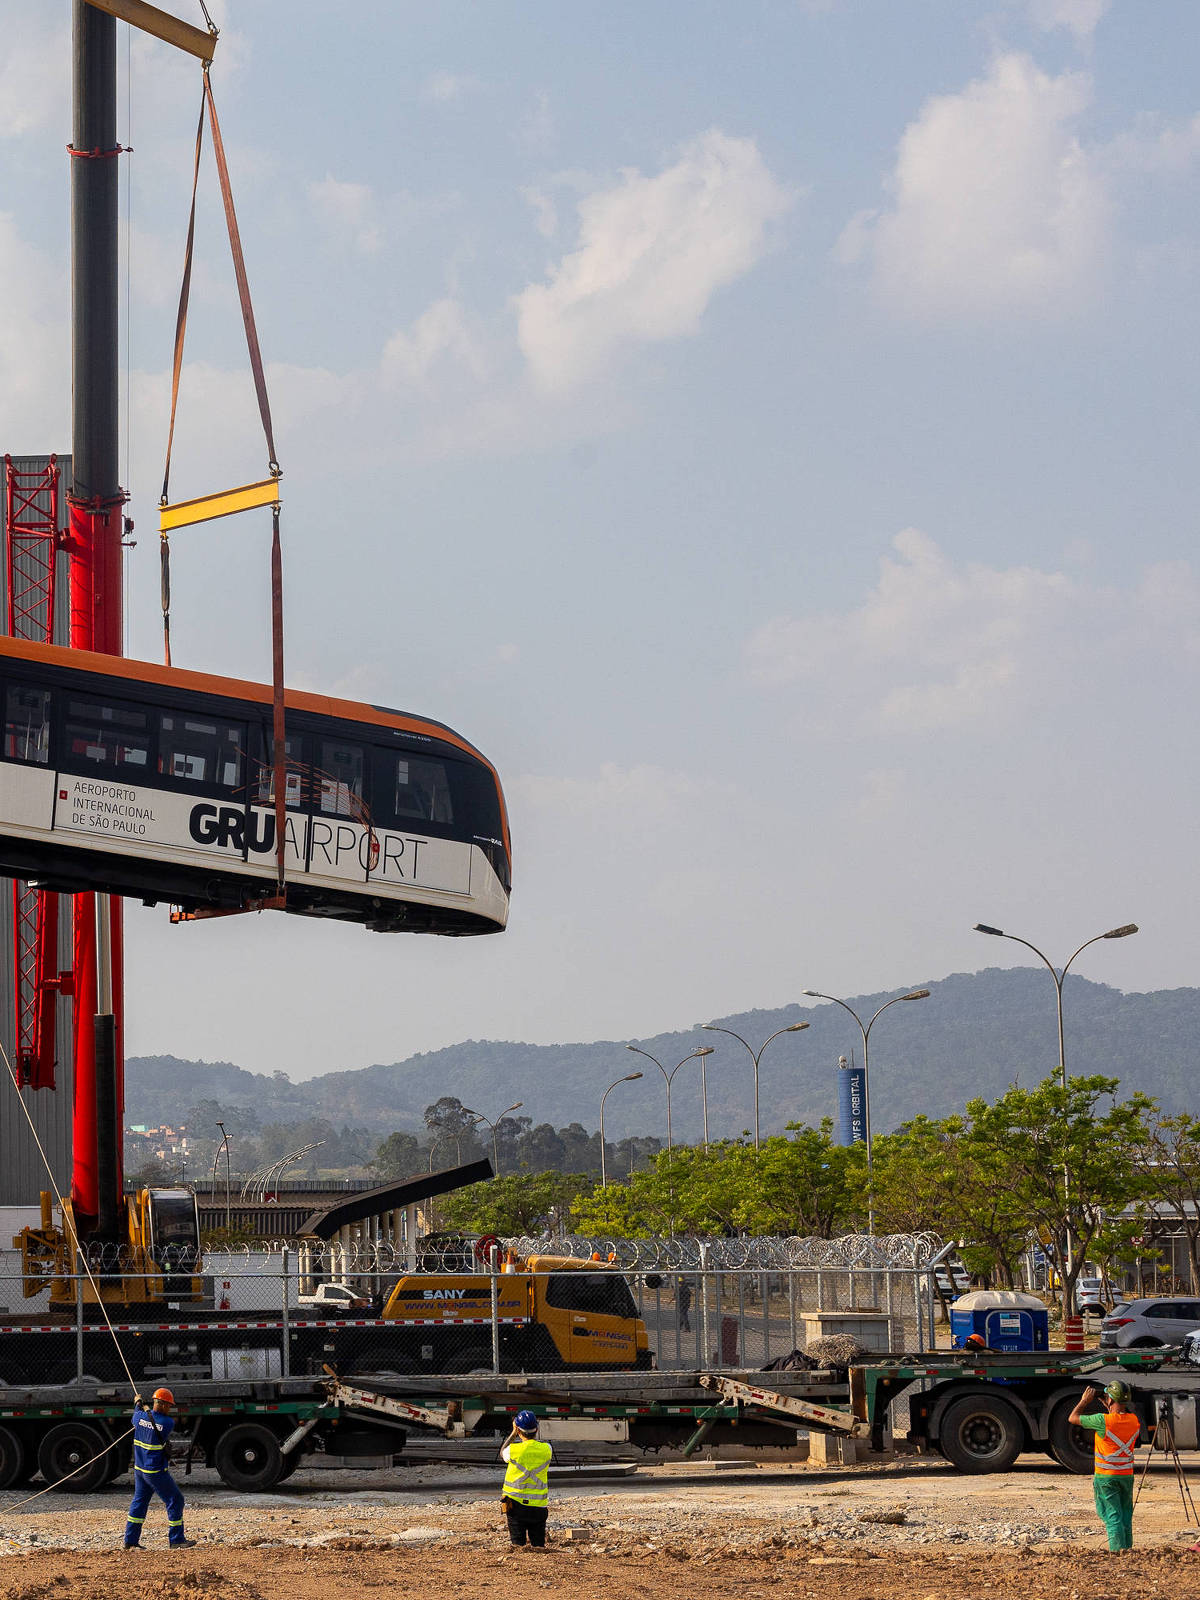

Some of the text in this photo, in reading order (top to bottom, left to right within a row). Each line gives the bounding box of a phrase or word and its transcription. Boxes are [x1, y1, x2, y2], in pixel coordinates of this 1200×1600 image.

[74, 781, 136, 802] AEROPORTO
[73, 797, 156, 821] INTERNACIONAL
[72, 812, 146, 835] DE SÃO PAULO
[851, 1074, 862, 1116] ORBITAL
[423, 1289, 466, 1300] SANY
